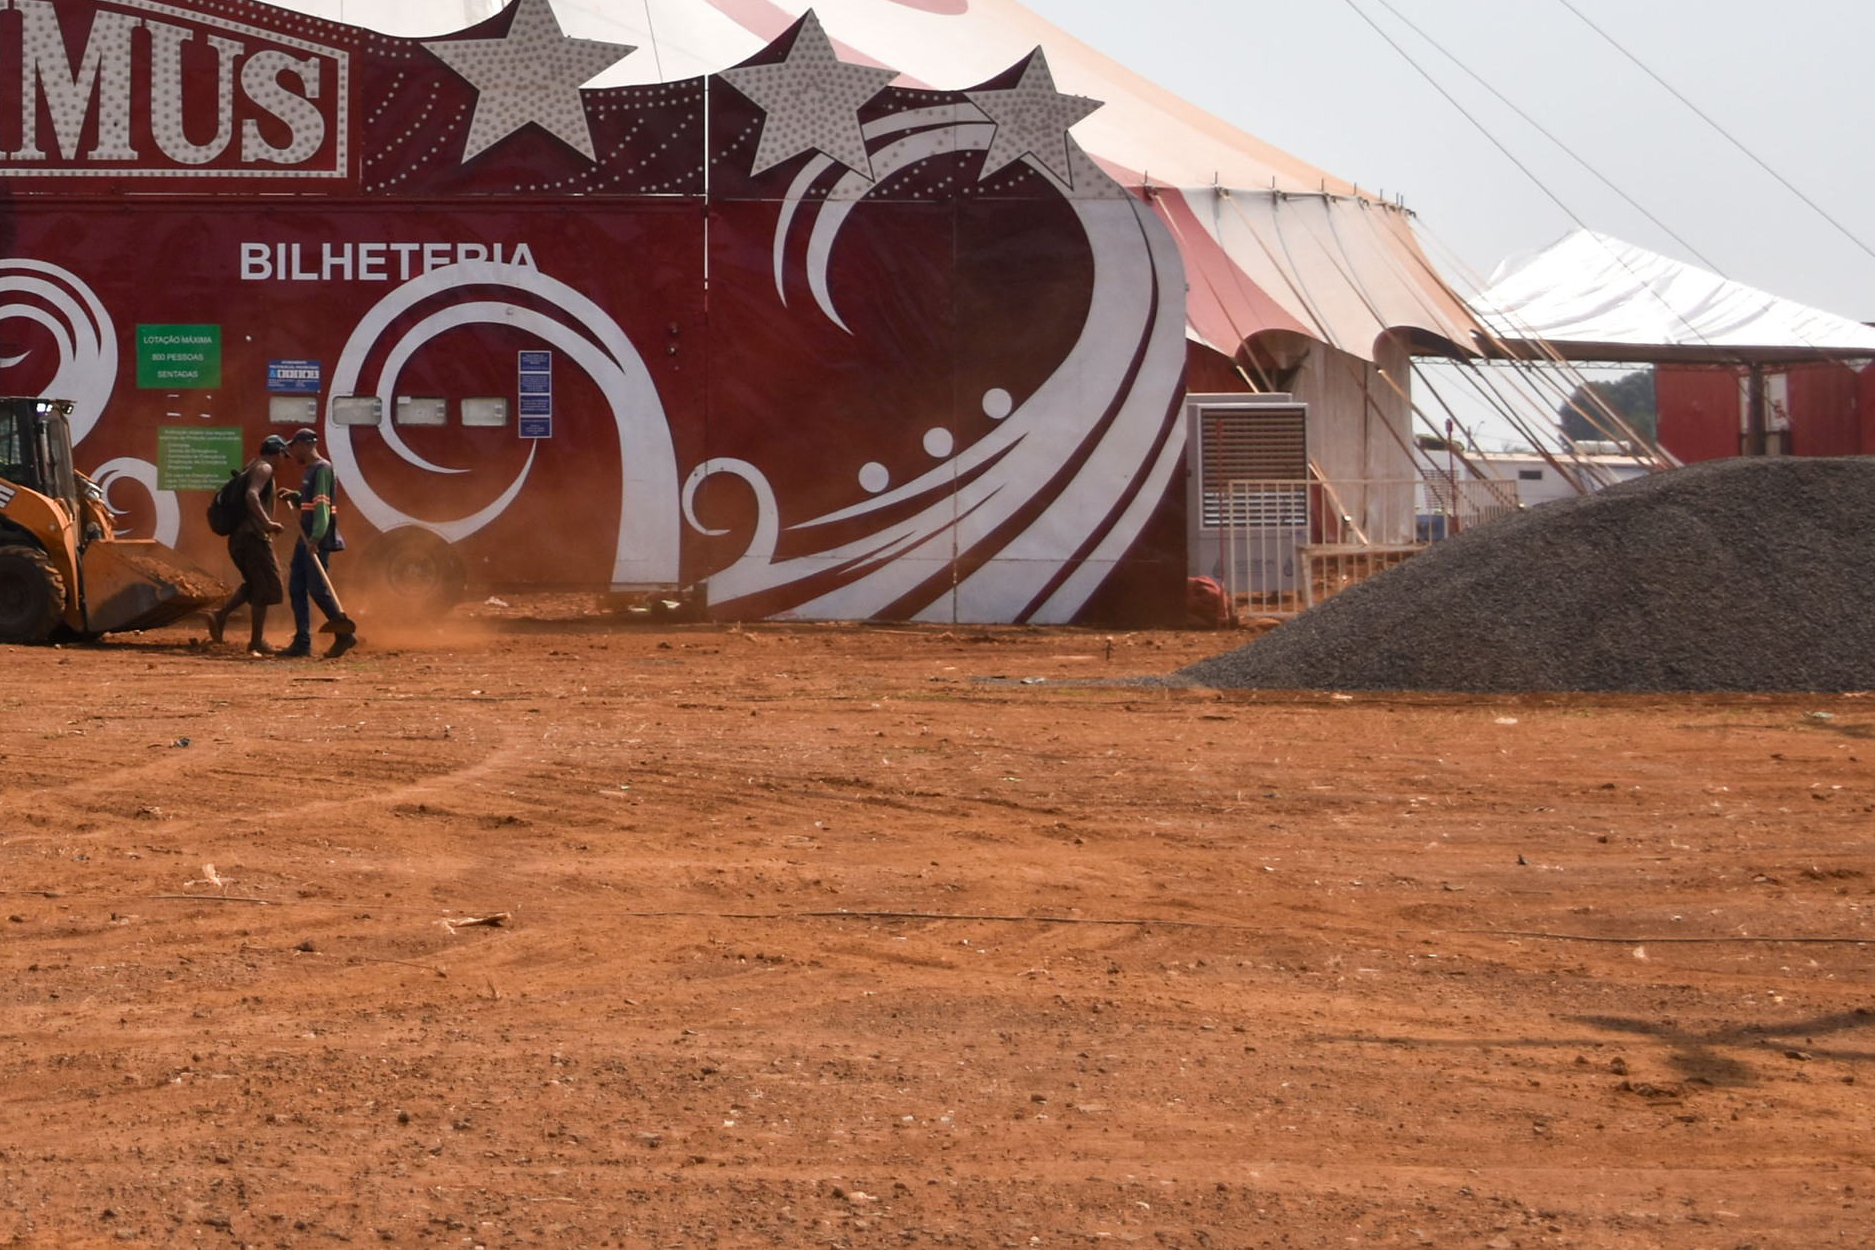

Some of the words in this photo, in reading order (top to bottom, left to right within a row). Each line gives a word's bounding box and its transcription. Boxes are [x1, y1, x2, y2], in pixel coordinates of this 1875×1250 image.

[143, 334, 180, 345] LOTAÇÃO
[181, 334, 213, 344] MÁXIMA
[152, 353, 165, 361] 800
[166, 353, 204, 361] PESSOAS
[157, 370, 199, 378] SENTADAS
